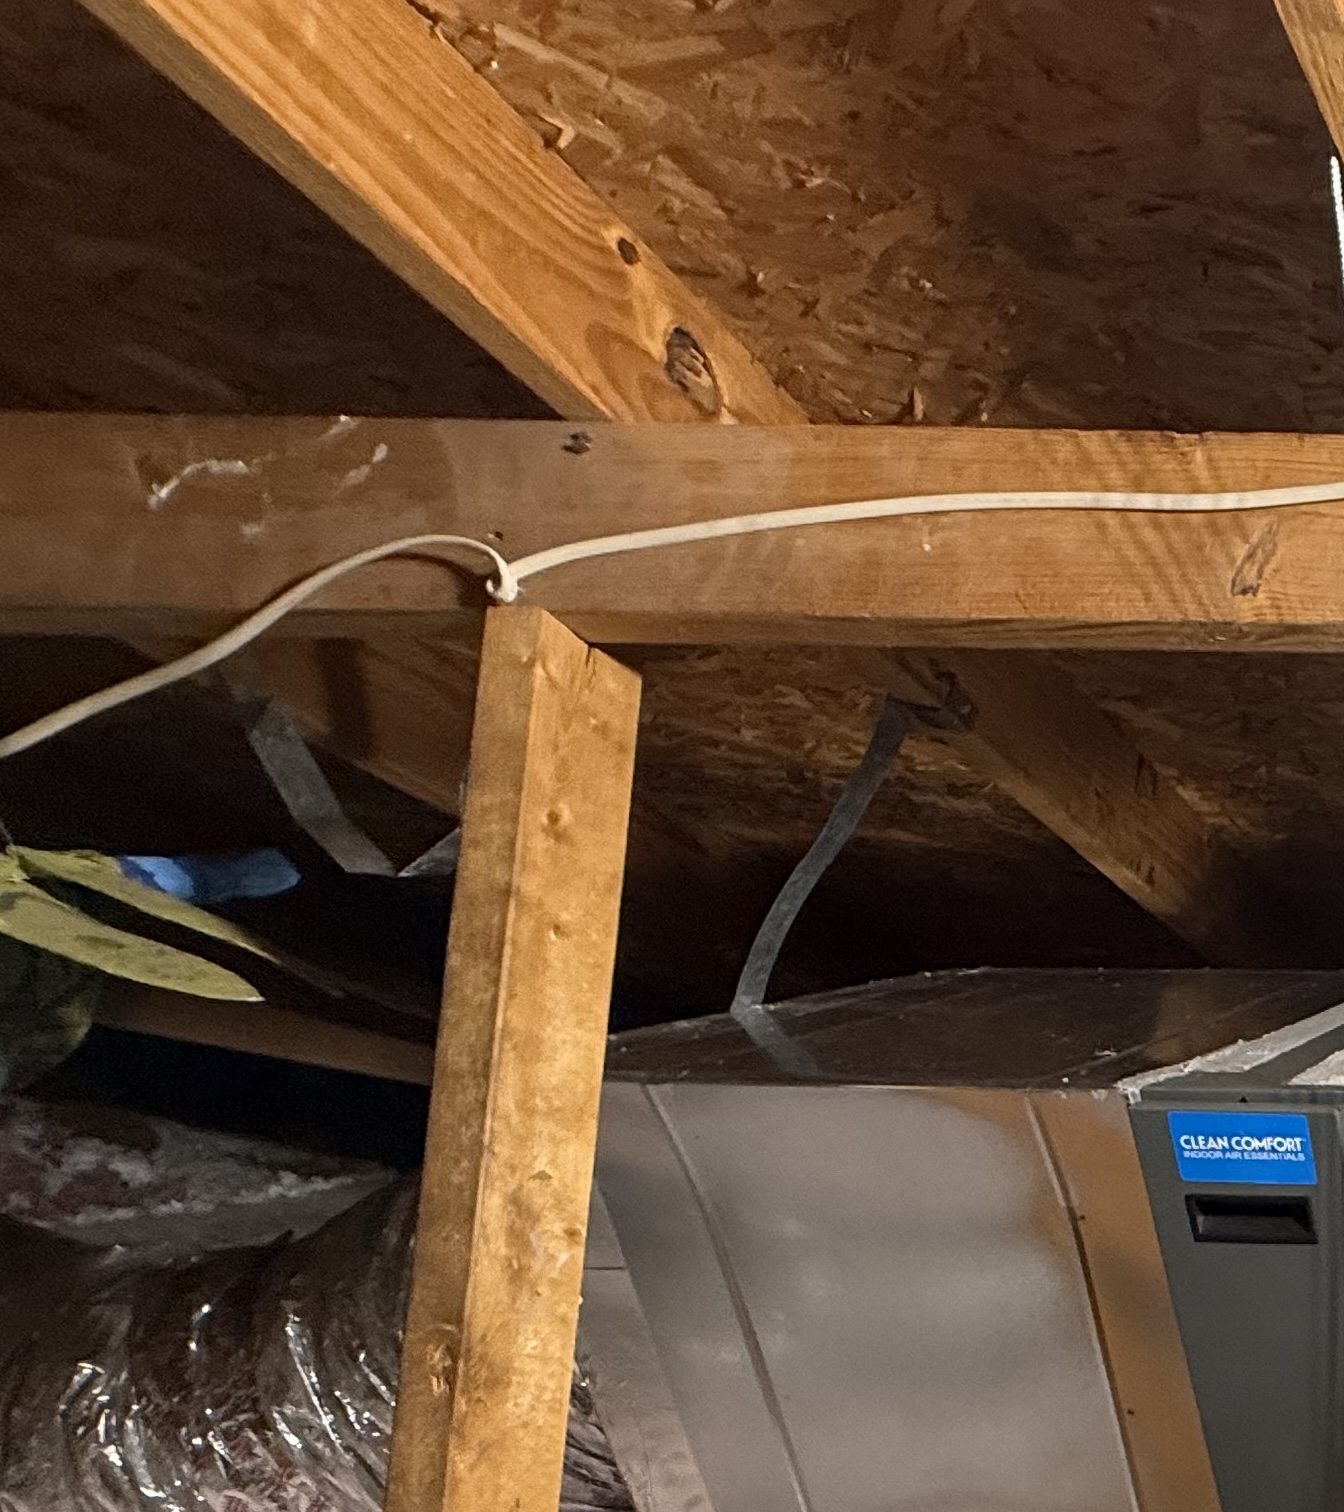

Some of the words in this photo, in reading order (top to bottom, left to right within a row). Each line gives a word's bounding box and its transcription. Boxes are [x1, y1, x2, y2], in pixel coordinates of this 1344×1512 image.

[1180, 1134, 1229, 1150] CLEAN
[1231, 1136, 1303, 1152] COMFORT
[1183, 1150, 1223, 1160] INDOOR
[1225, 1150, 1242, 1160] AIR
[1244, 1151, 1306, 1162] ESSENTIALS
